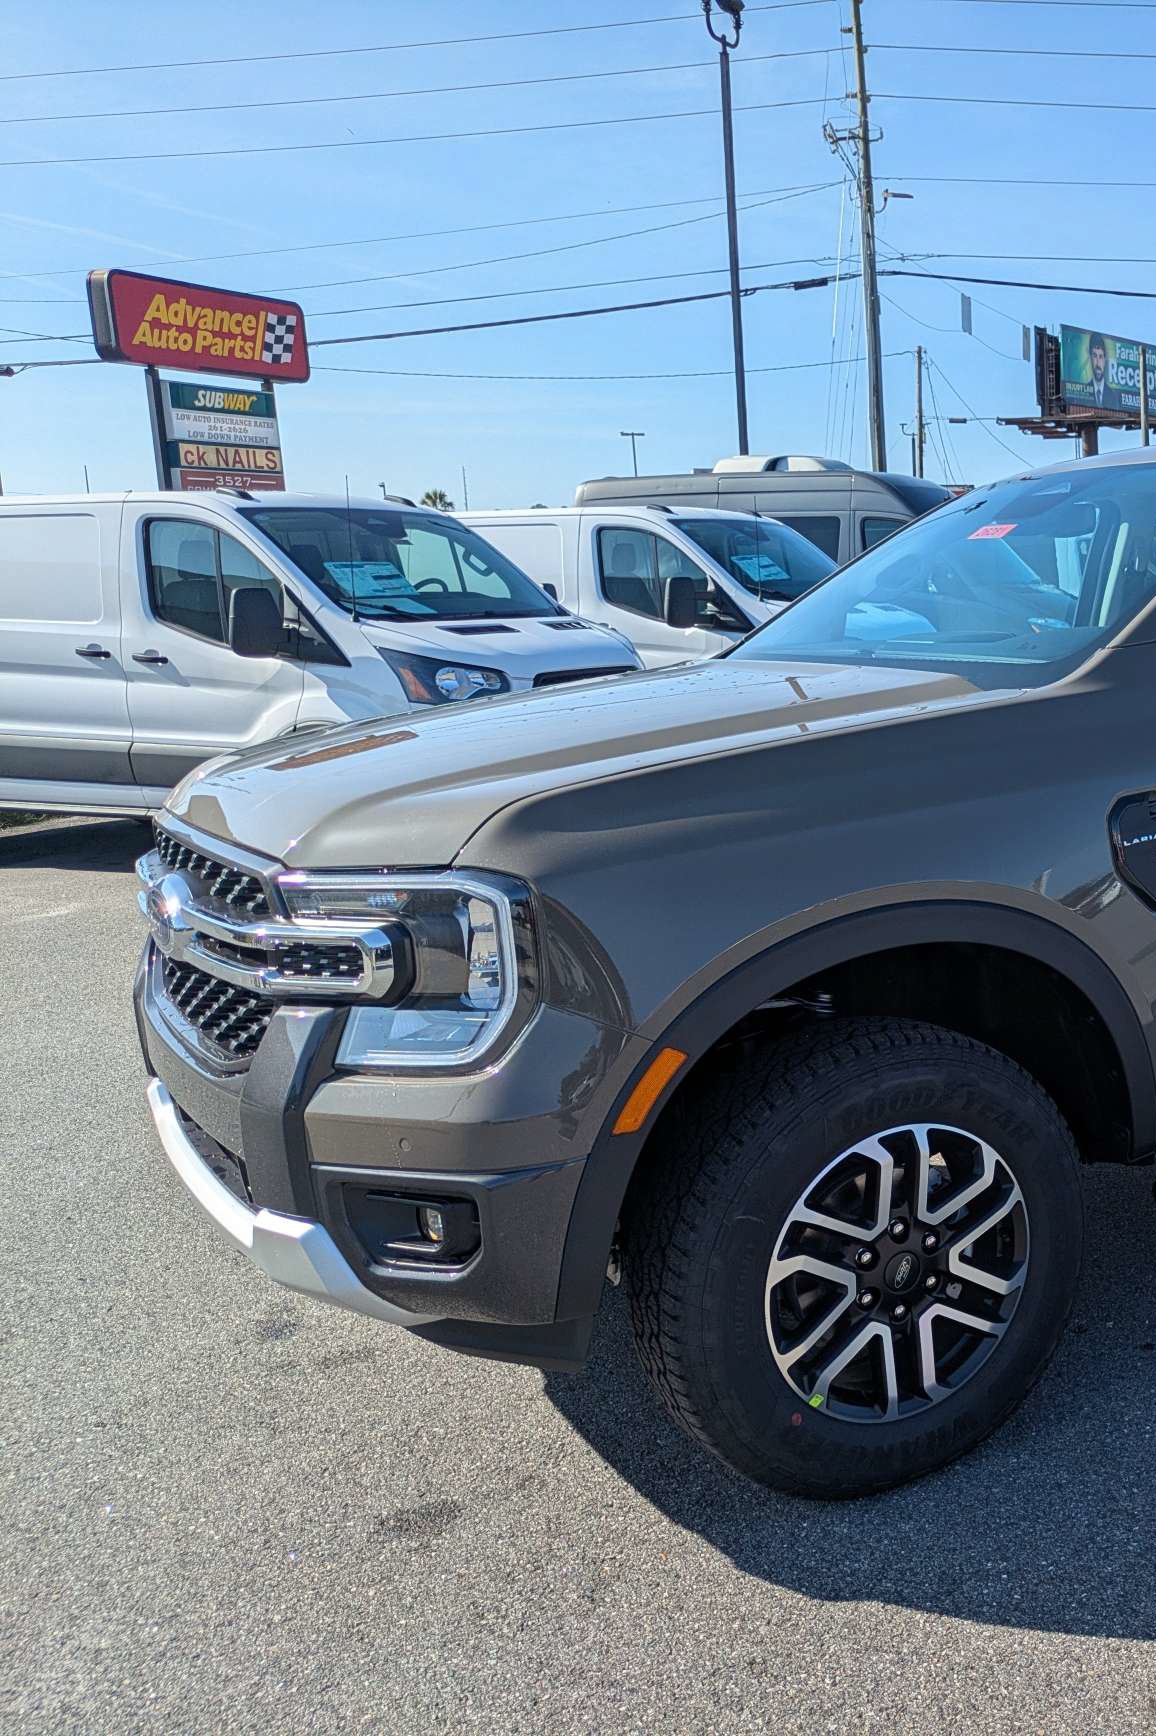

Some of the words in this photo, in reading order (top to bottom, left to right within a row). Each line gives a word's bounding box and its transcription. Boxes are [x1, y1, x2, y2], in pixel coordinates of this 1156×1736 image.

[144, 293, 257, 336] Advance
[132, 321, 193, 352] Auto
[195, 329, 254, 360] Parts
[1116, 342, 1139, 361] Farah
[193, 390, 257, 411] SUBWAY
[176, 413, 192, 421] LOW
[193, 414, 211, 424] AUTO
[213, 416, 252, 427] INSURANCE
[254, 420, 274, 429] RATES
[187, 430, 206, 439] LOW
[208, 432, 232, 441] DOWN
[234, 434, 269, 444] PAYMENT
[184, 446, 208, 467] ck
[215, 447, 278, 470] NAILS
[215, 476, 251, 487] 3527
